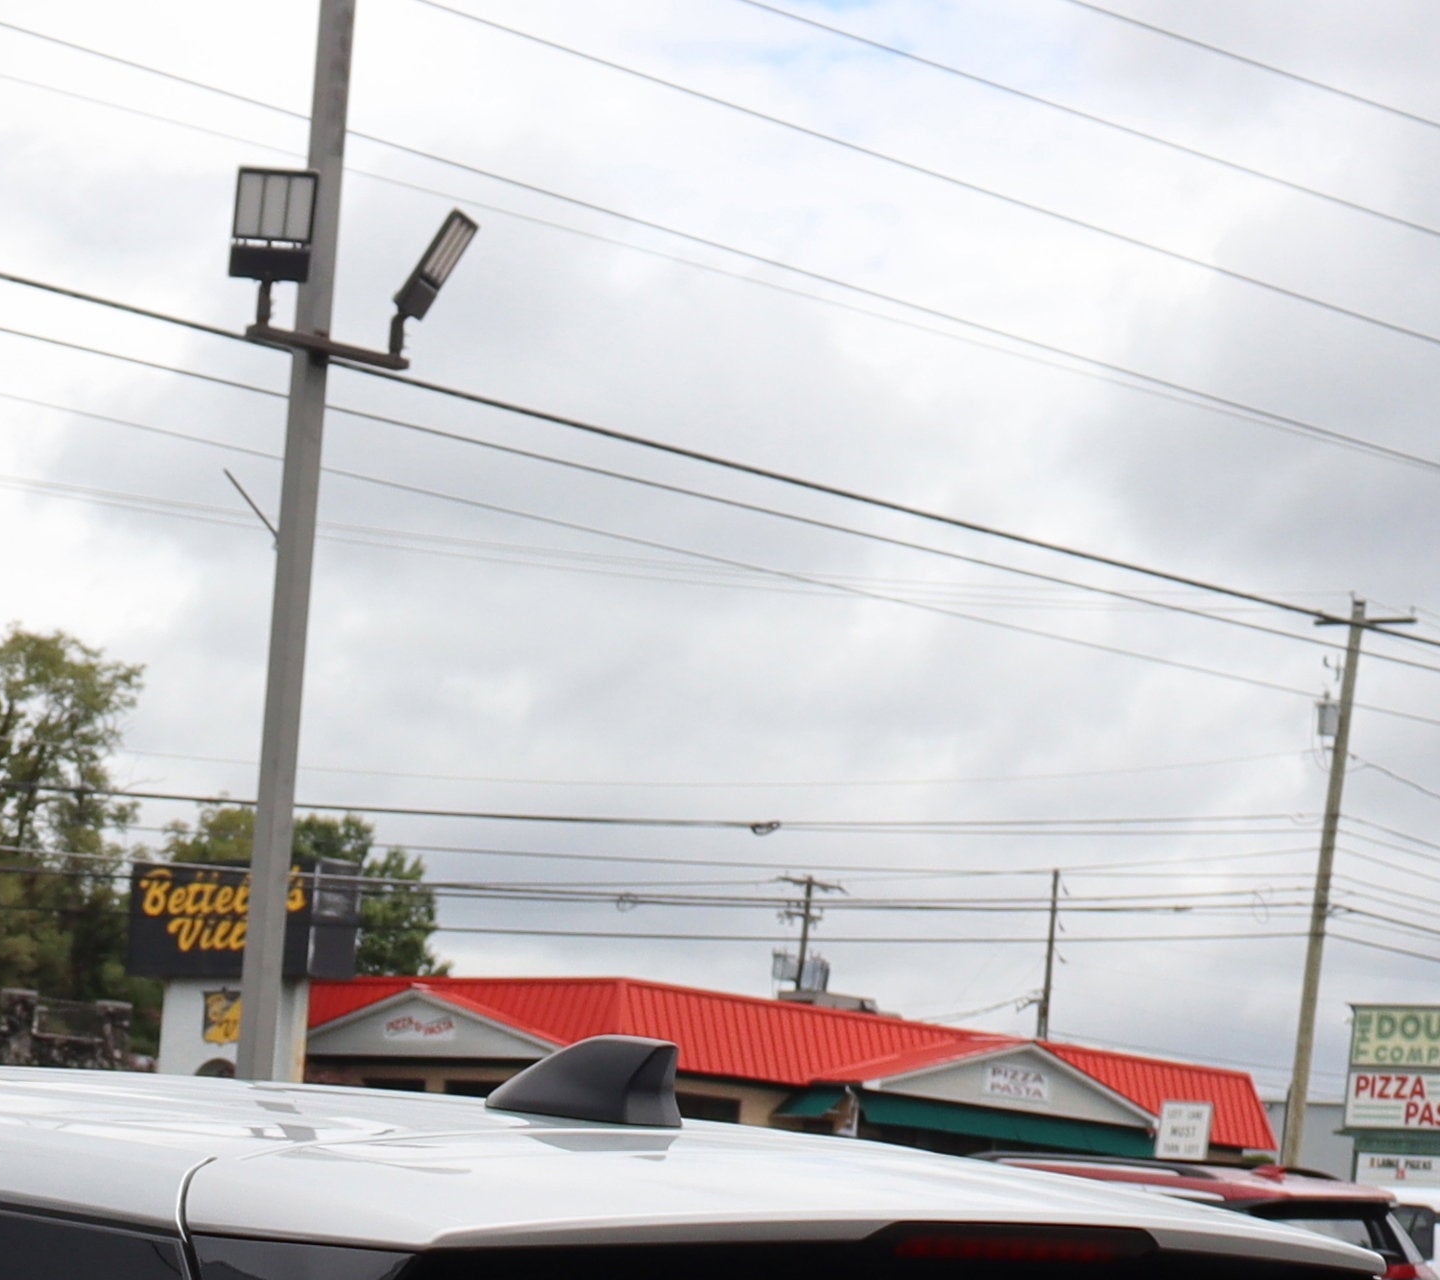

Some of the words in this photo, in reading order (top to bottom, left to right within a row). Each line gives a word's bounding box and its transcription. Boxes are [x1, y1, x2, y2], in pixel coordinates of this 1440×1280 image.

[167, 915, 250, 952] Vill
[992, 1066, 1045, 1083] PIZZA
[1355, 1074, 1426, 1100] PIZZA
